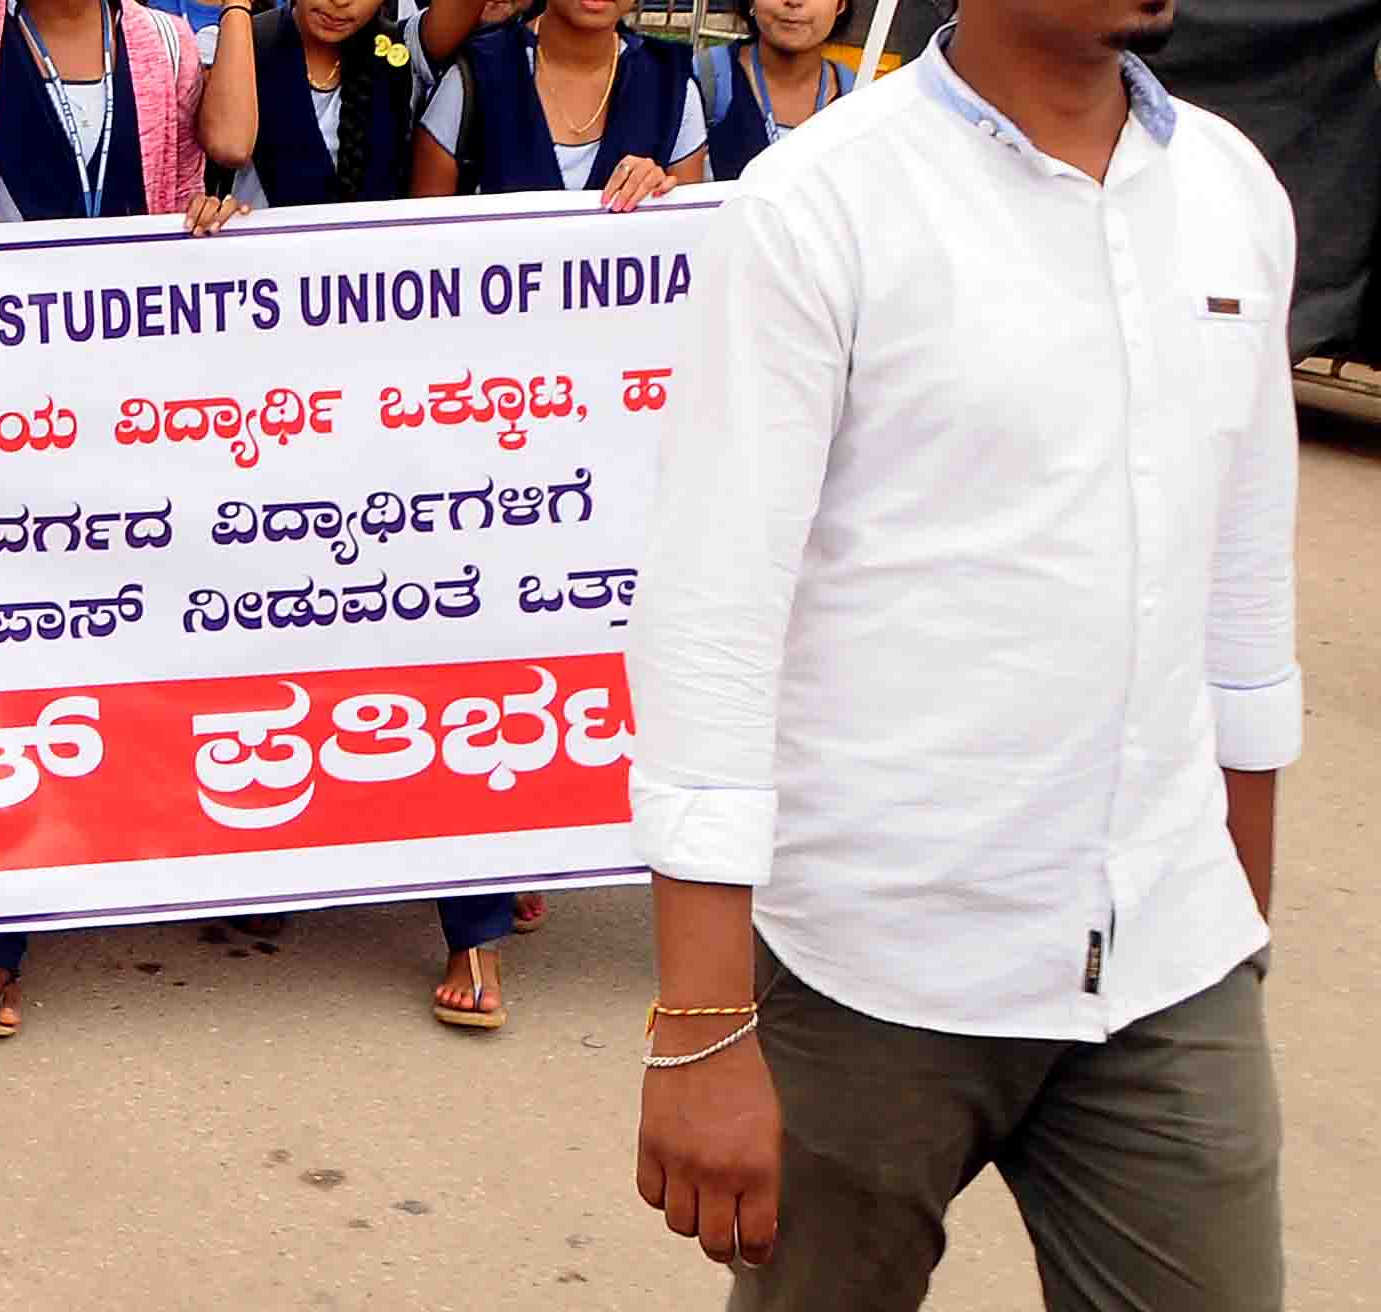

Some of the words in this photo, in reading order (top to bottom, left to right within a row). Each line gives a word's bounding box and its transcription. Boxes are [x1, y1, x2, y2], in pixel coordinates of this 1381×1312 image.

[300, 268, 460, 326] UNION
[480, 262, 543, 315] OF
[564, 253, 692, 310] INDIA
[114, 387, 343, 469] ವಿದ್ಯಾರ್ಥಿ
[379, 368, 588, 450] ಒಕ್ಕೂಟ,
[621, 367, 674, 413] ಹ
[211, 468, 593, 566] ವಿದ್ಯಾರ್ಥಿಗಳಿಗೆ
[182, 564, 481, 633] ನೀಡುವಂತೆ
[191, 665, 634, 829] ಪ್ರತಿಭಟ
